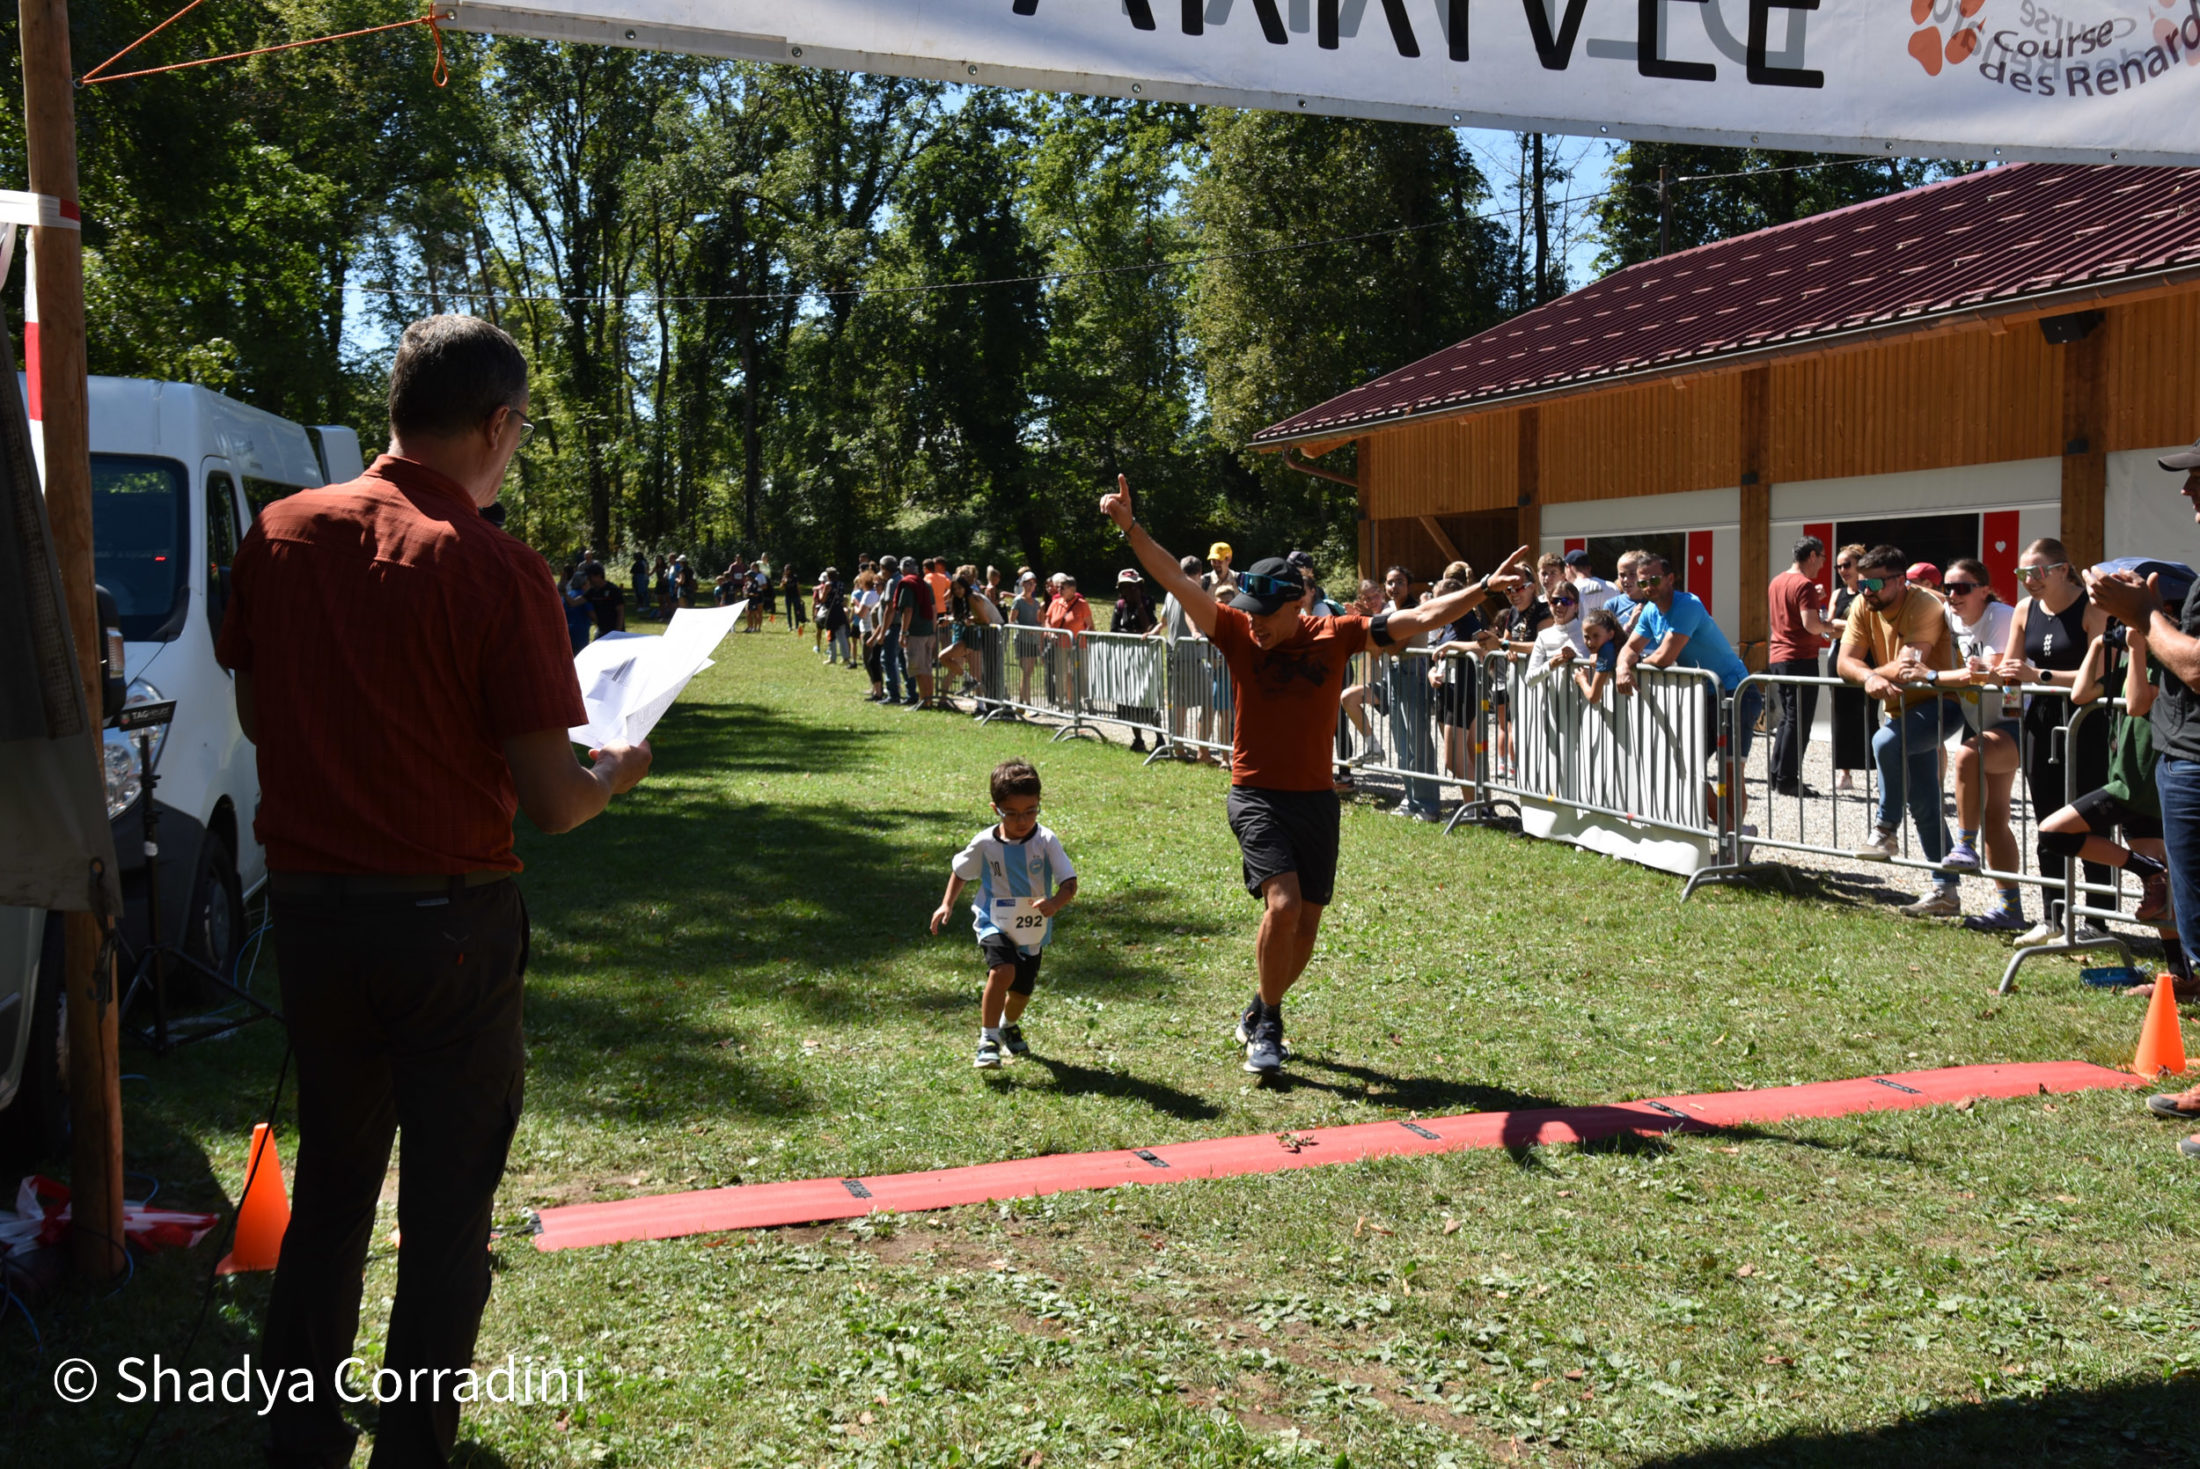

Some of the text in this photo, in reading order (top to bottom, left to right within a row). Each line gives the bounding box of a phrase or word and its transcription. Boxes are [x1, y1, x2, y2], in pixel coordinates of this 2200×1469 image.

[1993, 19, 2114, 60] Course
[1979, 61, 2056, 97] des
[1015, 915, 1043, 929] 292
